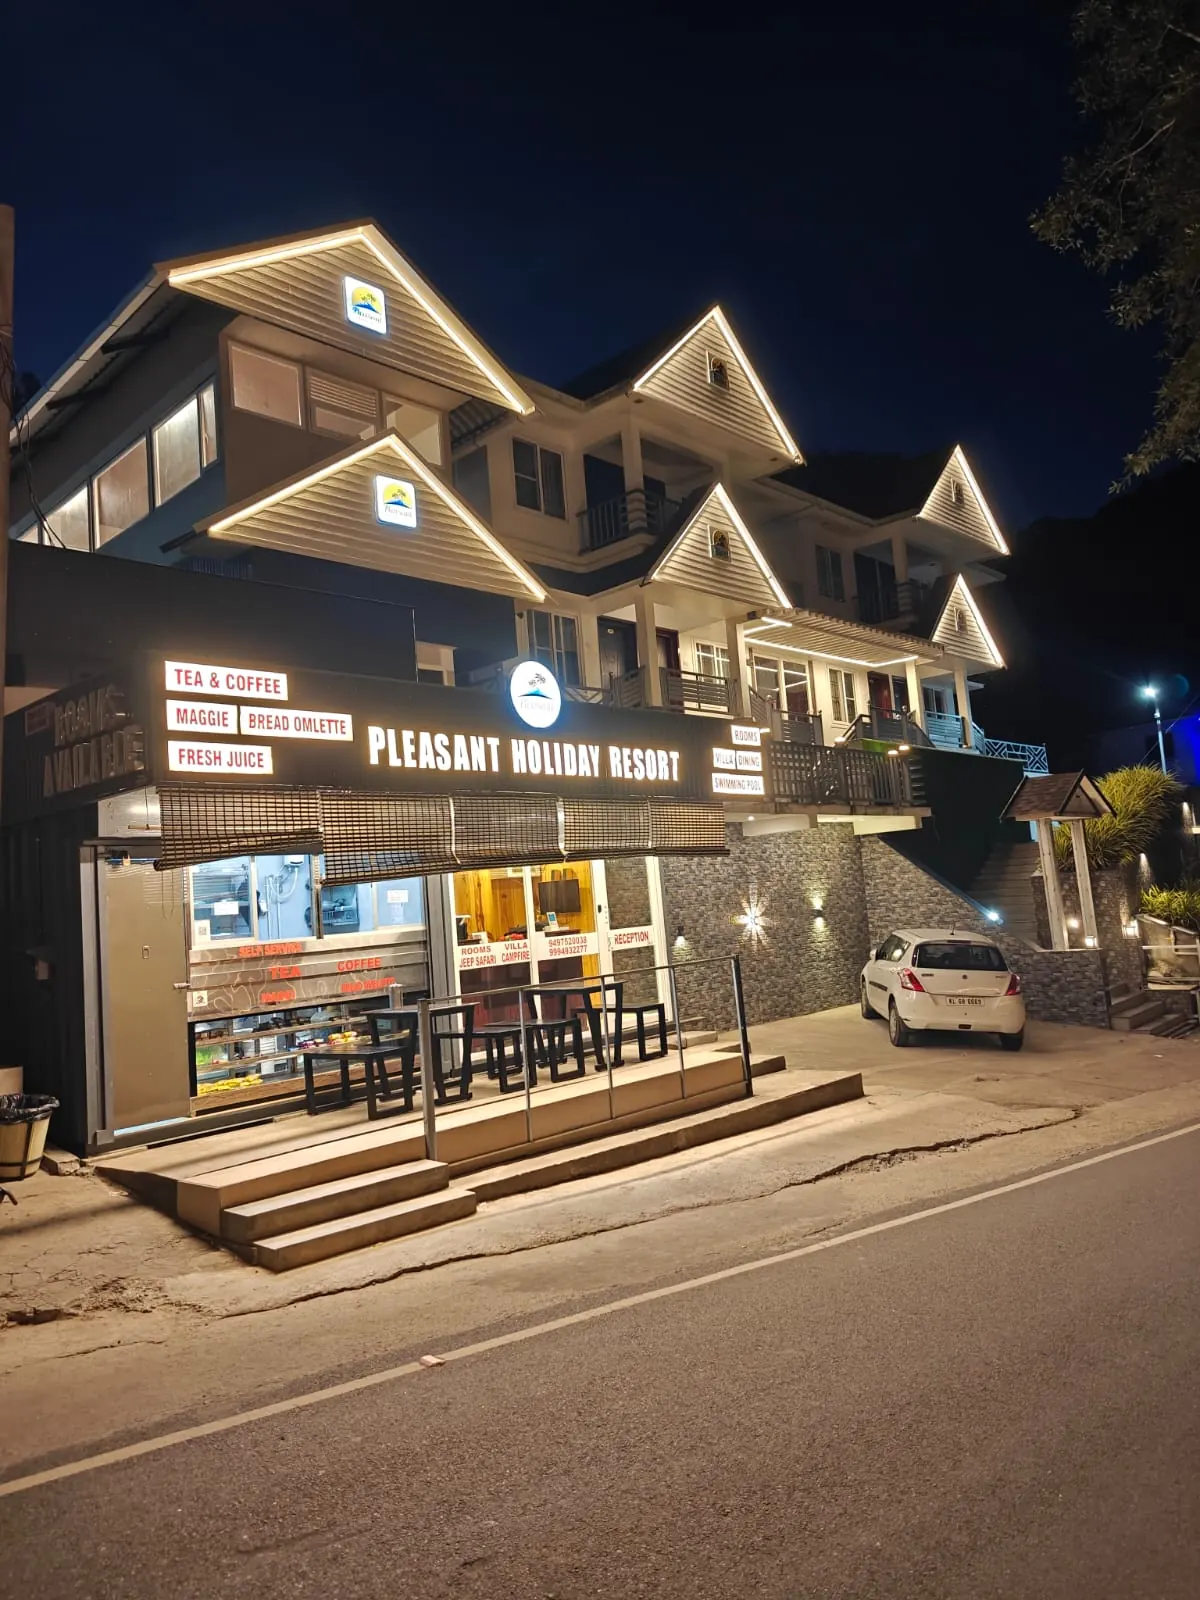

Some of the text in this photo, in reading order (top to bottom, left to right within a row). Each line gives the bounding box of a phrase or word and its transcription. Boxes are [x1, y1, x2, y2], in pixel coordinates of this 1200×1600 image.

[174, 669, 281, 694] TEA & COFFEE
[176, 708, 229, 727] MAGGIE
[249, 713, 346, 735] BREAD OMLETTE
[734, 729, 758, 742] ROOMS
[178, 748, 264, 768] FRESH JUICE
[367, 725, 679, 781] PLEASANT HOLIDAY RESORT
[715, 752, 734, 765] VILLA
[738, 755, 760, 767] DINING
[714, 777, 761, 791] SWIMMING POOL
[614, 931, 649, 945] RECEPTION
[461, 945, 491, 956] ROOMS
[504, 941, 528, 950] VILLA
[459, 954, 497, 968] JEEP SAFARI
[501, 950, 530, 963] CAMPFIRE
[336, 957, 382, 972] COFFEE
[269, 965, 301, 980] TEA
